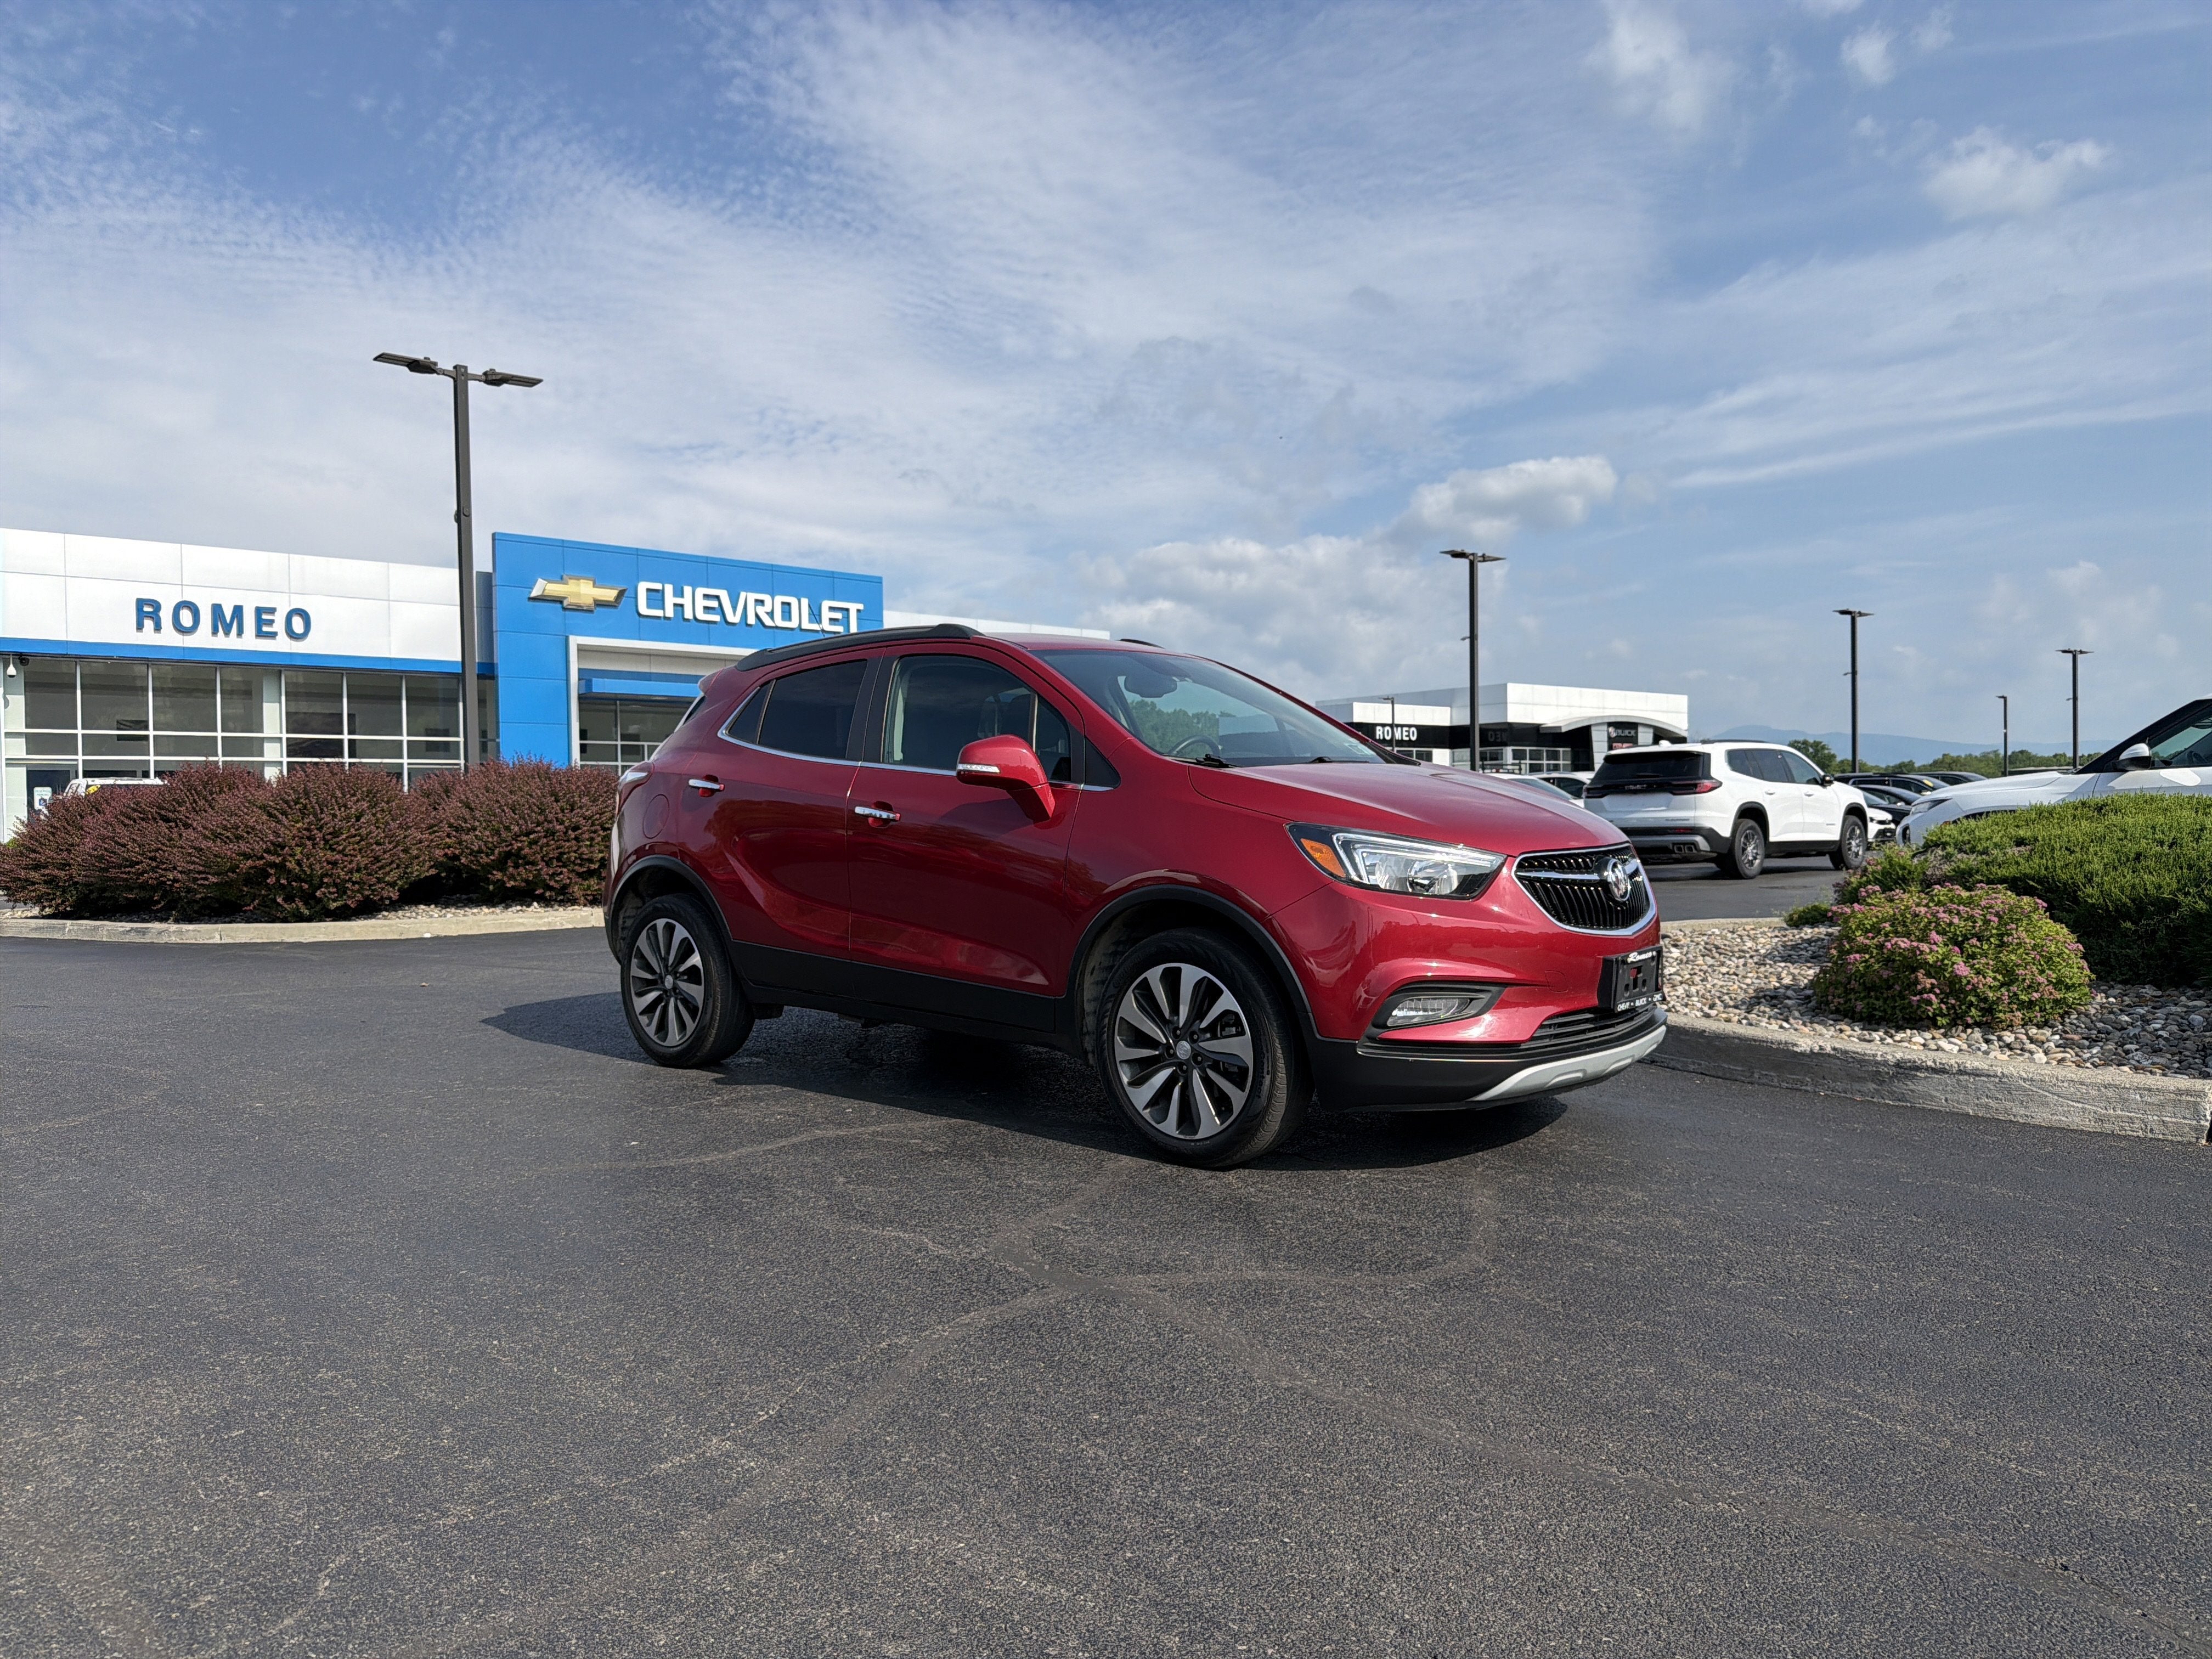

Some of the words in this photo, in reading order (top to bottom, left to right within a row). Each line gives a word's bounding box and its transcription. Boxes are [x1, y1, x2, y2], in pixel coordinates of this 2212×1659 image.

[135, 597, 312, 640] ROMEO
[637, 582, 864, 633] CHEVROLET
[1376, 726, 1418, 741] ROMEO
[1617, 1002, 1630, 1011] CHEVY
[1635, 997, 1647, 1006] BUICK
